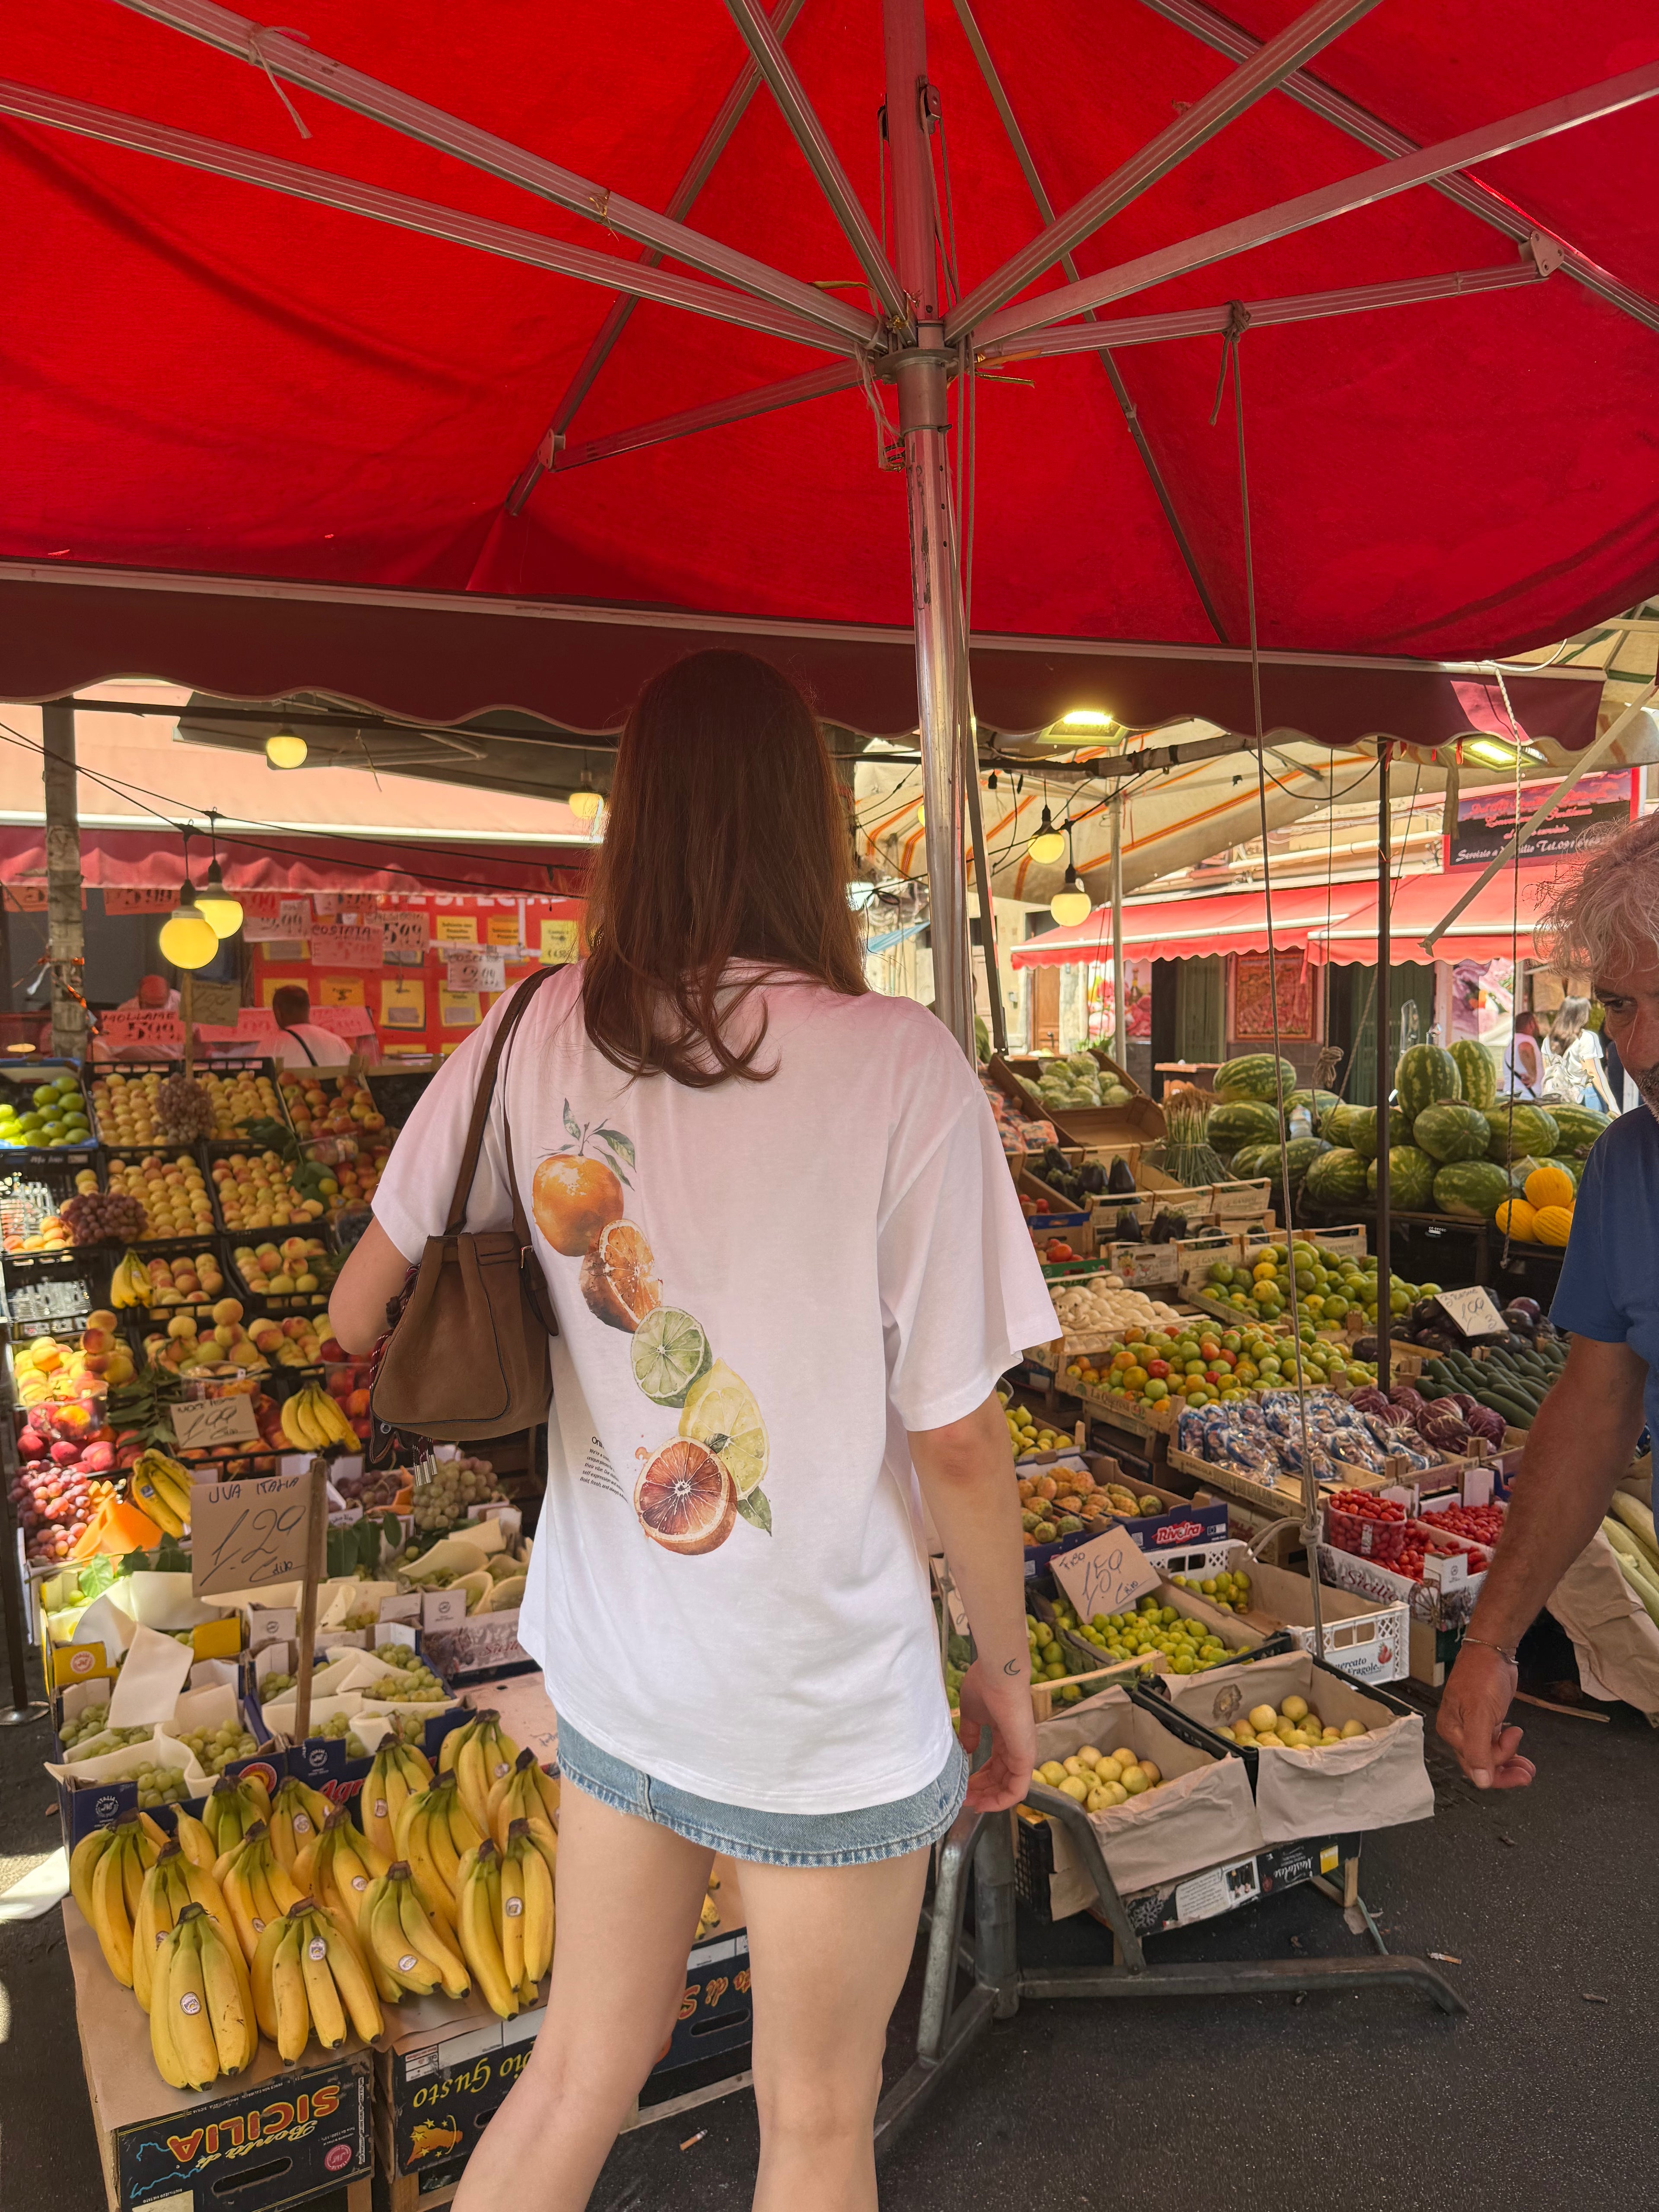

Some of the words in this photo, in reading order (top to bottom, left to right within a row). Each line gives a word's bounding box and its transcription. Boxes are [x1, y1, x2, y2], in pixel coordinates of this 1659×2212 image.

[209, 1484, 243, 1504] UVA
[1156, 1522, 1202, 1545] Rivoira
[412, 2057, 491, 2108] Gusto
[167, 2085, 340, 2162] SICILIA
